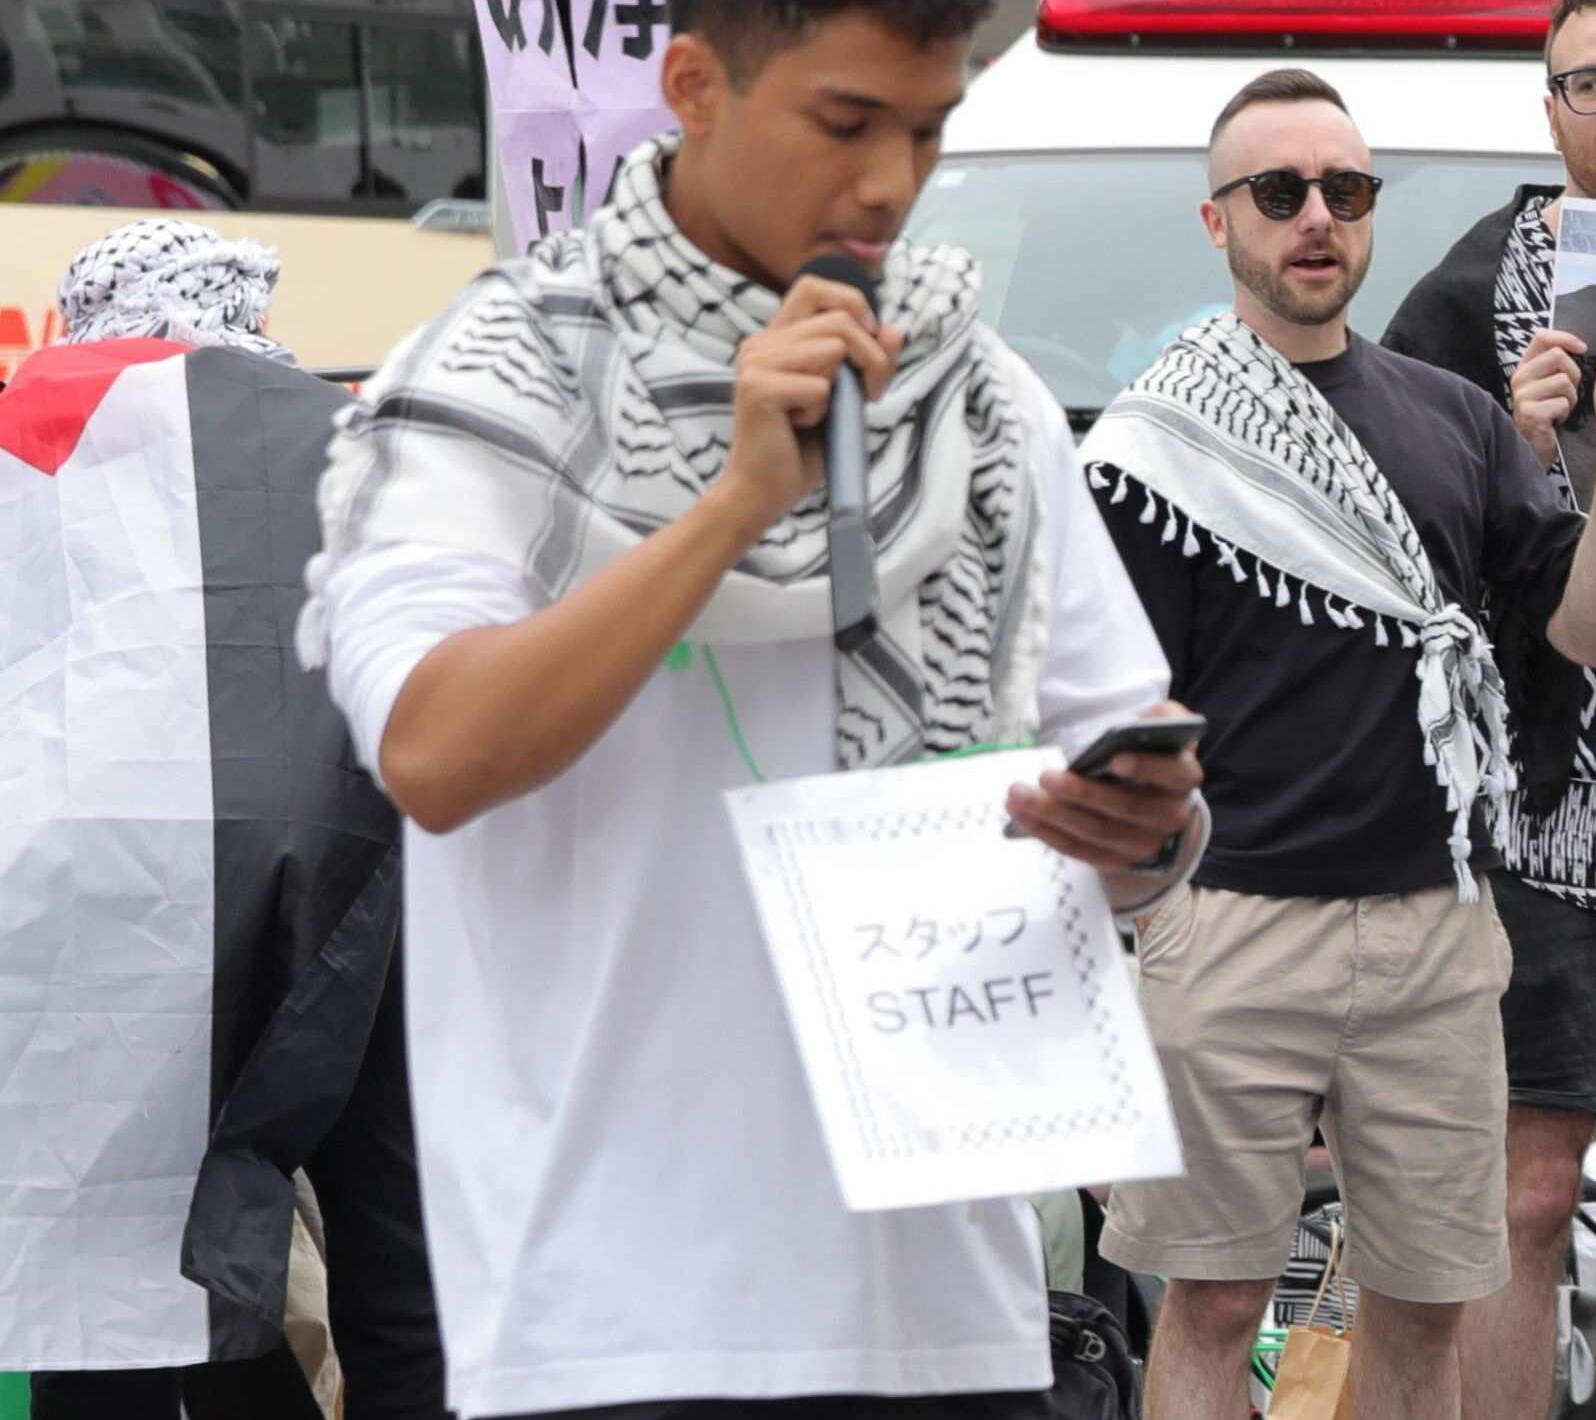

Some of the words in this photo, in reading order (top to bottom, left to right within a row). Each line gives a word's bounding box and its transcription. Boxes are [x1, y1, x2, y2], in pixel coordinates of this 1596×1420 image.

[856, 903, 1029, 966] スタッフ
[866, 971, 1057, 1038] STAFF
